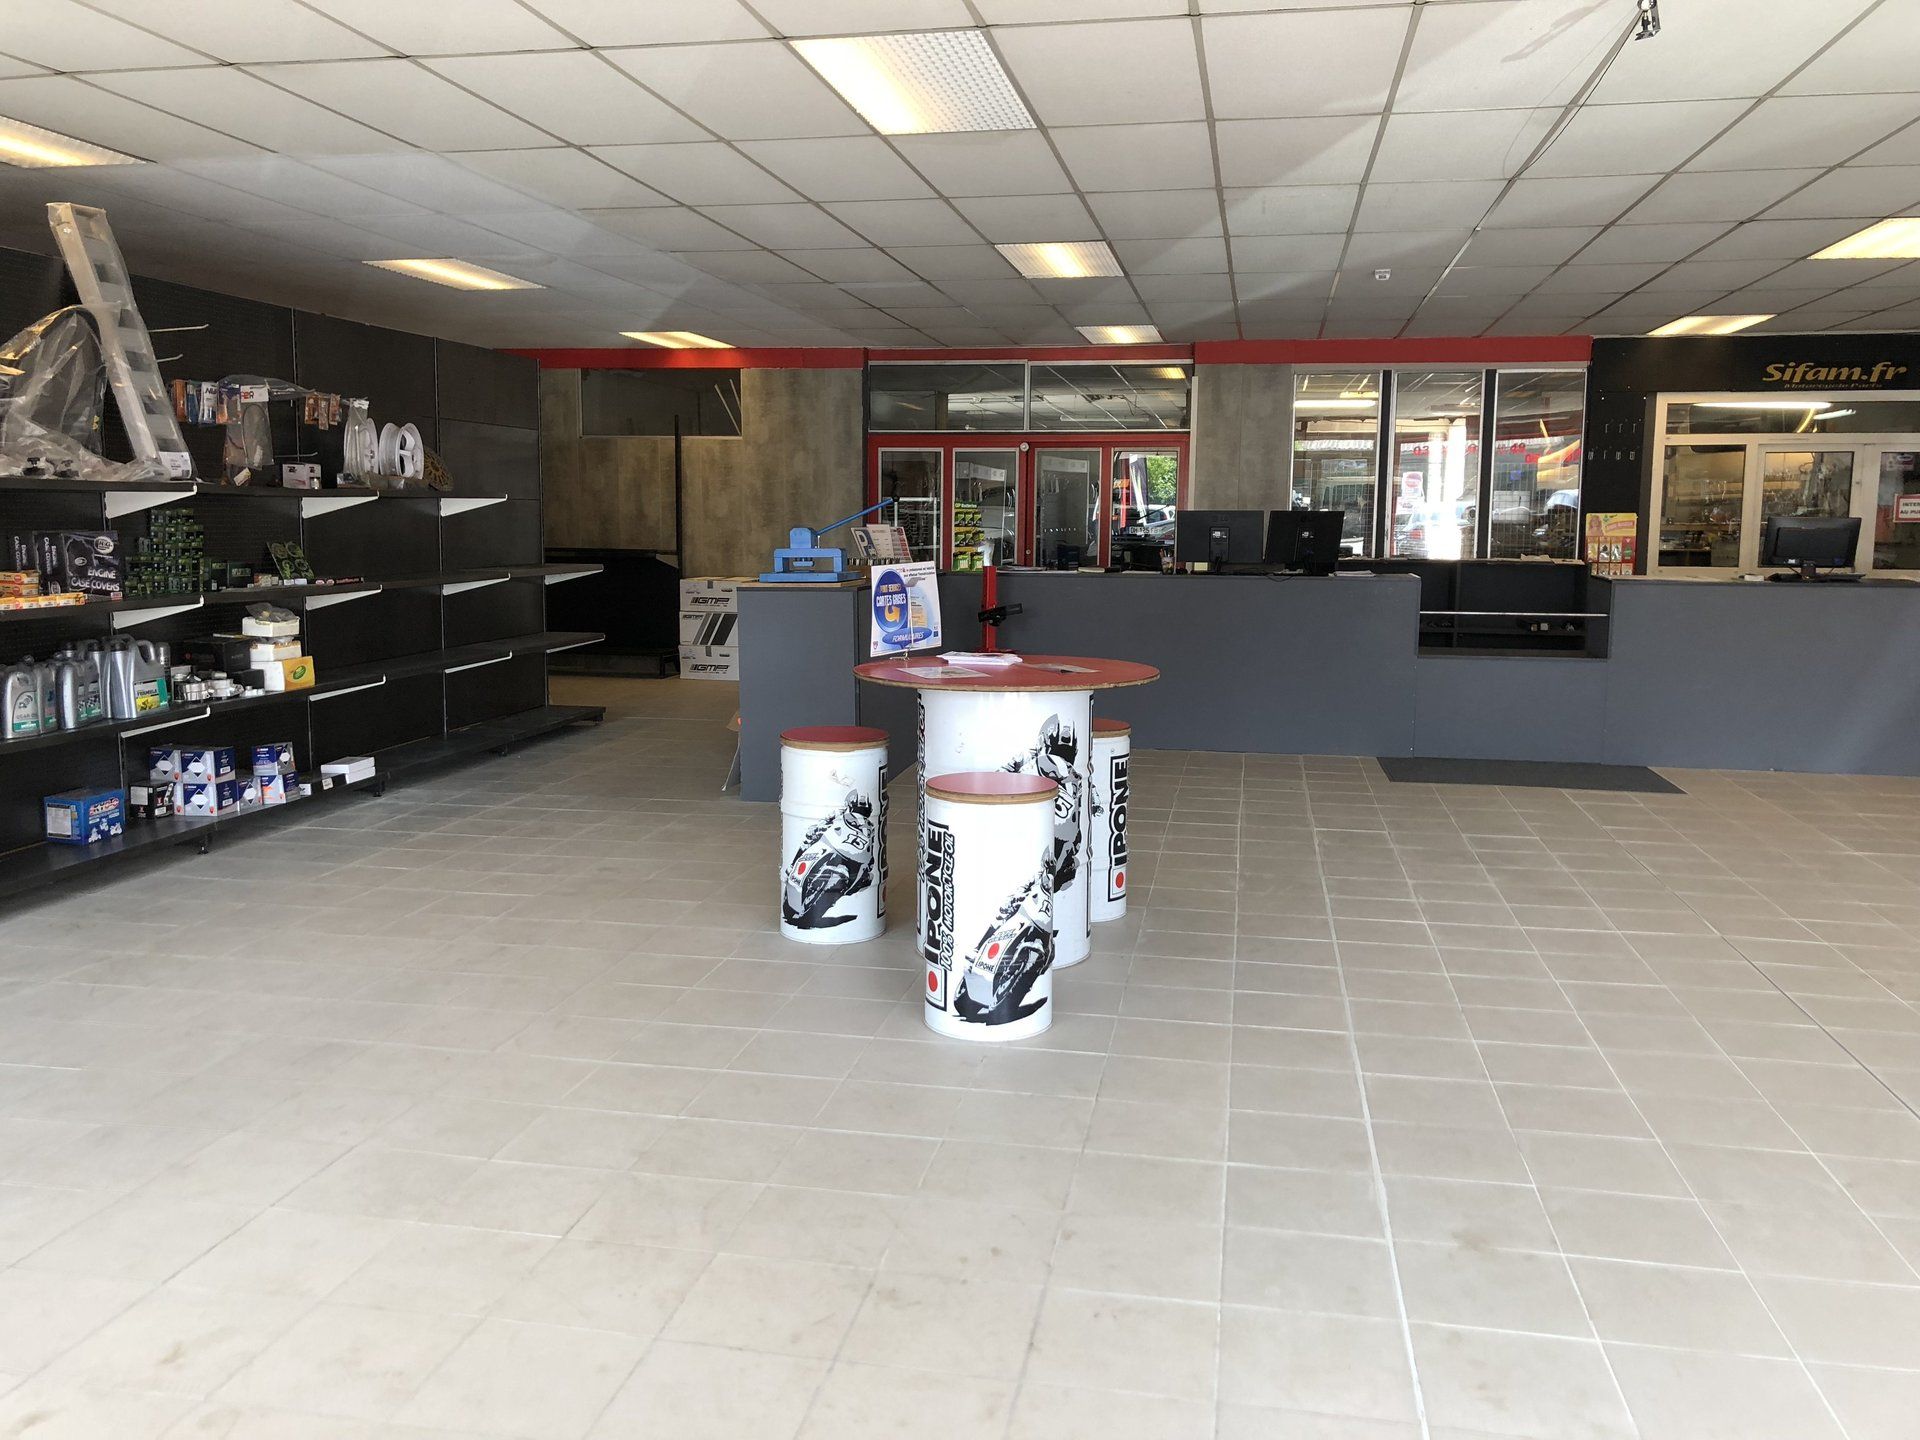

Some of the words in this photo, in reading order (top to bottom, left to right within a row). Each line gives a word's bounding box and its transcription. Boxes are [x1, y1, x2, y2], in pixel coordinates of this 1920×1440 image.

[1762, 361, 1907, 383] Sifam.fr
[71, 577, 90, 588] CASE
[91, 579, 120, 592] COVERS
[87, 568, 116, 579] ENGINE
[1114, 760, 1128, 867] IPONE
[944, 831, 954, 854] OIL
[925, 828, 943, 965] IPONE
[942, 853, 954, 932] MOTORCYCLE
[939, 928, 954, 972] 100%
